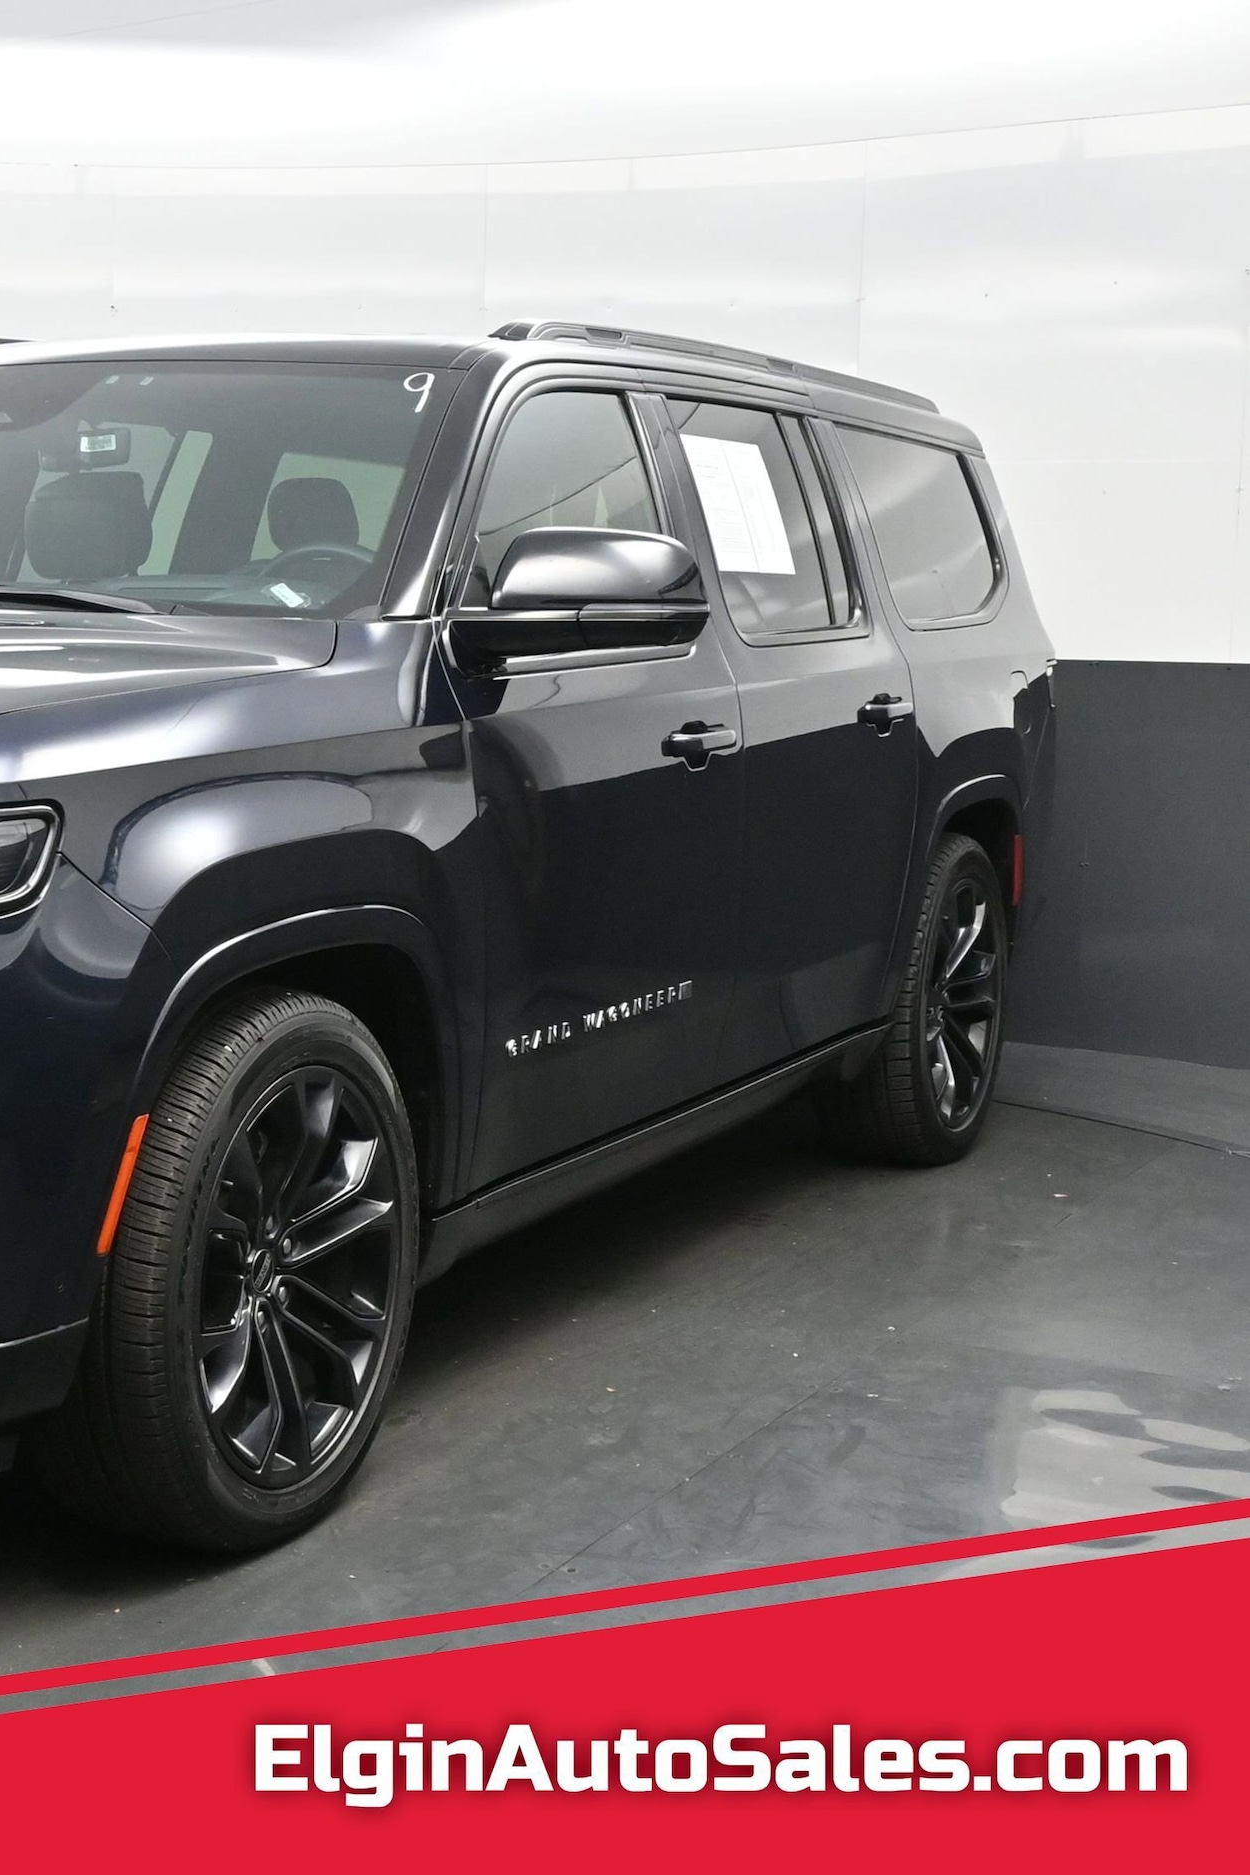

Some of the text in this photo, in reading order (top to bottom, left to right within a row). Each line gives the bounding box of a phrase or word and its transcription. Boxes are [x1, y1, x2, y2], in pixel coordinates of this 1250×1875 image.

[403, 372, 435, 413] 9
[505, 1022, 571, 1057] GRAND
[582, 986, 676, 1032] WAGONEER
